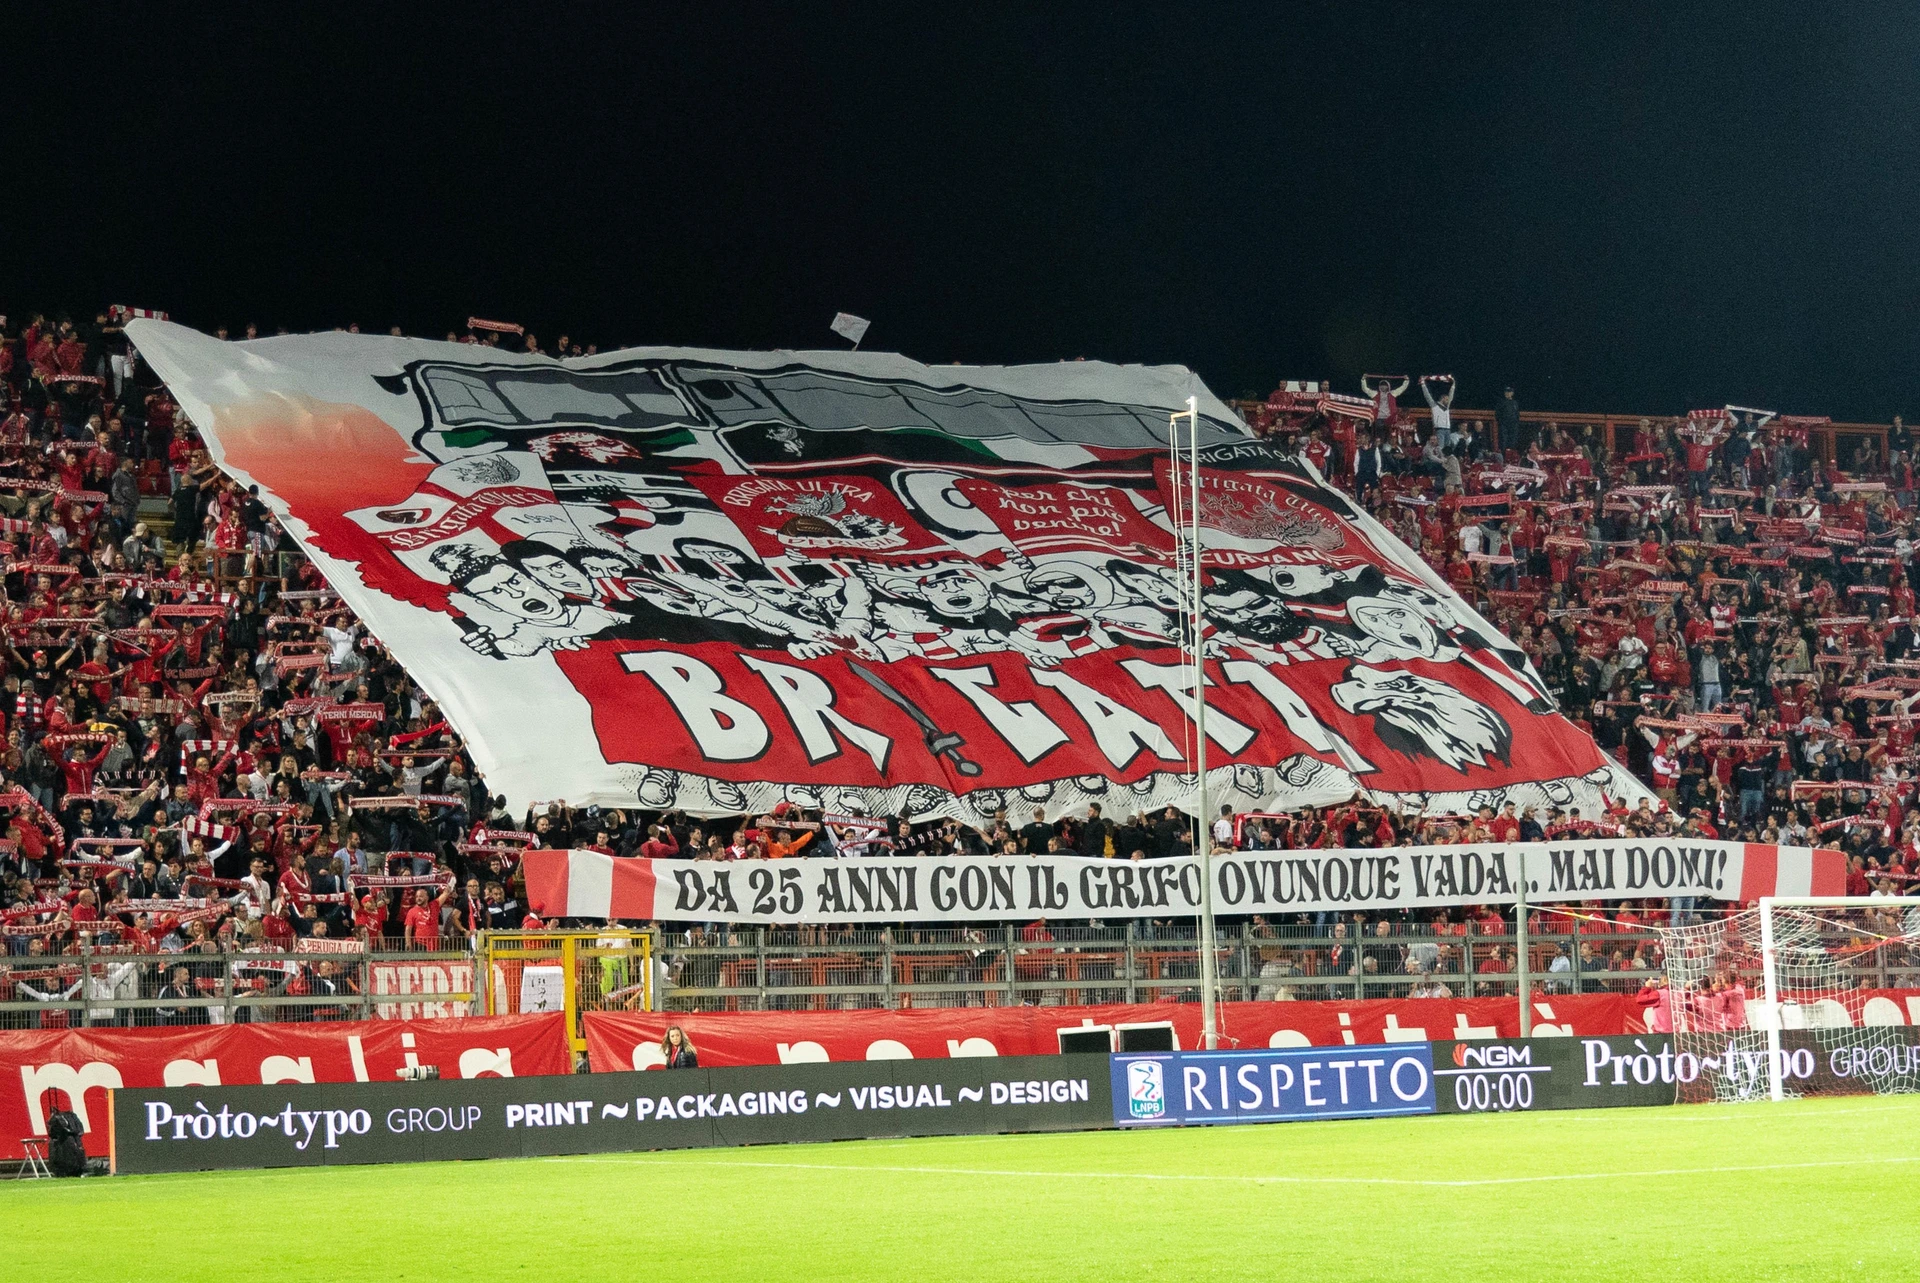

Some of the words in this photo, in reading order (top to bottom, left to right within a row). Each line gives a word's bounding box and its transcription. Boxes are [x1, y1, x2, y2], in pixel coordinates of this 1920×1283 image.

[1178, 445, 1272, 464] BRIGATA
[1273, 449, 1300, 467] 94
[570, 472, 628, 486] FIAT
[722, 479, 795, 507] BRIGATA
[1066, 490, 1112, 507] chi
[999, 497, 1062, 515] non
[1013, 518, 1123, 537] venire!
[788, 537, 898, 547] PERUGIA
[1199, 551, 1289, 566] CURVA
[323, 711, 347, 720] TERNI
[349, 710, 377, 720] MERDA
[55, 733, 109, 743] PERUGIA
[487, 830, 498, 838] AC
[498, 830, 531, 840] PERUGIA
[673, 868, 739, 914] DA
[749, 867, 804, 915] 25
[817, 865, 919, 914] ANNI
[930, 864, 1017, 912] CON
[1026, 864, 1069, 911] IL
[1079, 863, 1203, 910] GRIFO
[1218, 854, 1401, 906] OVUNQUE
[1548, 847, 1616, 893] MAI
[8, 923, 66, 935] PERUGIA
[306, 940, 342, 953] PERUGIA
[1464, 1045, 1531, 1067] NGM
[1183, 1056, 1428, 1112] RISPETTO
[1455, 1072, 1533, 1111] 00:00
[506, 1100, 594, 1128] PRINT
[636, 1090, 808, 1121] PACKAGING
[848, 1084, 952, 1110] VISUAL
[990, 1078, 1089, 1105] DESIGN
[1133, 1101, 1161, 1114] LNPB
[144, 1101, 372, 1149] Pròto~typo
[387, 1105, 482, 1133] GROUP
